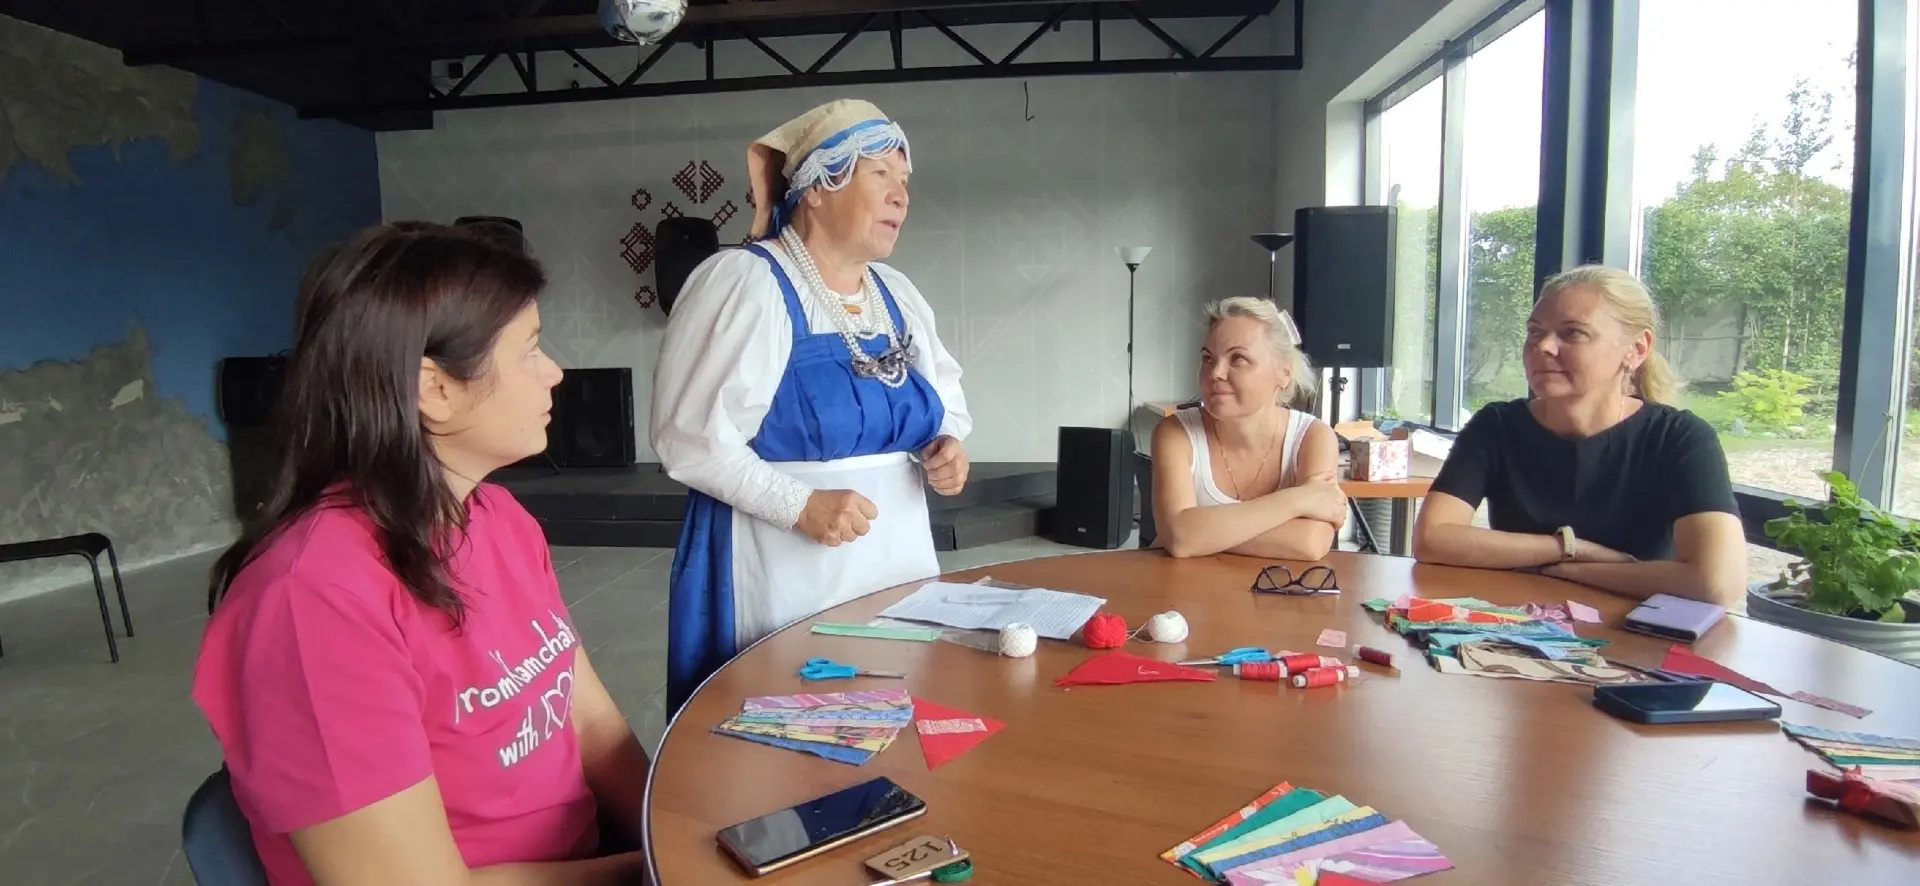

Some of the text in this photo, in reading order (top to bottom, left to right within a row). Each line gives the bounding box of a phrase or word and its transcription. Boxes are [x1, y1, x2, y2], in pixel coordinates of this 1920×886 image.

[455, 677, 521, 724] rom
[499, 706, 539, 767] with
[884, 841, 943, 872] 125
